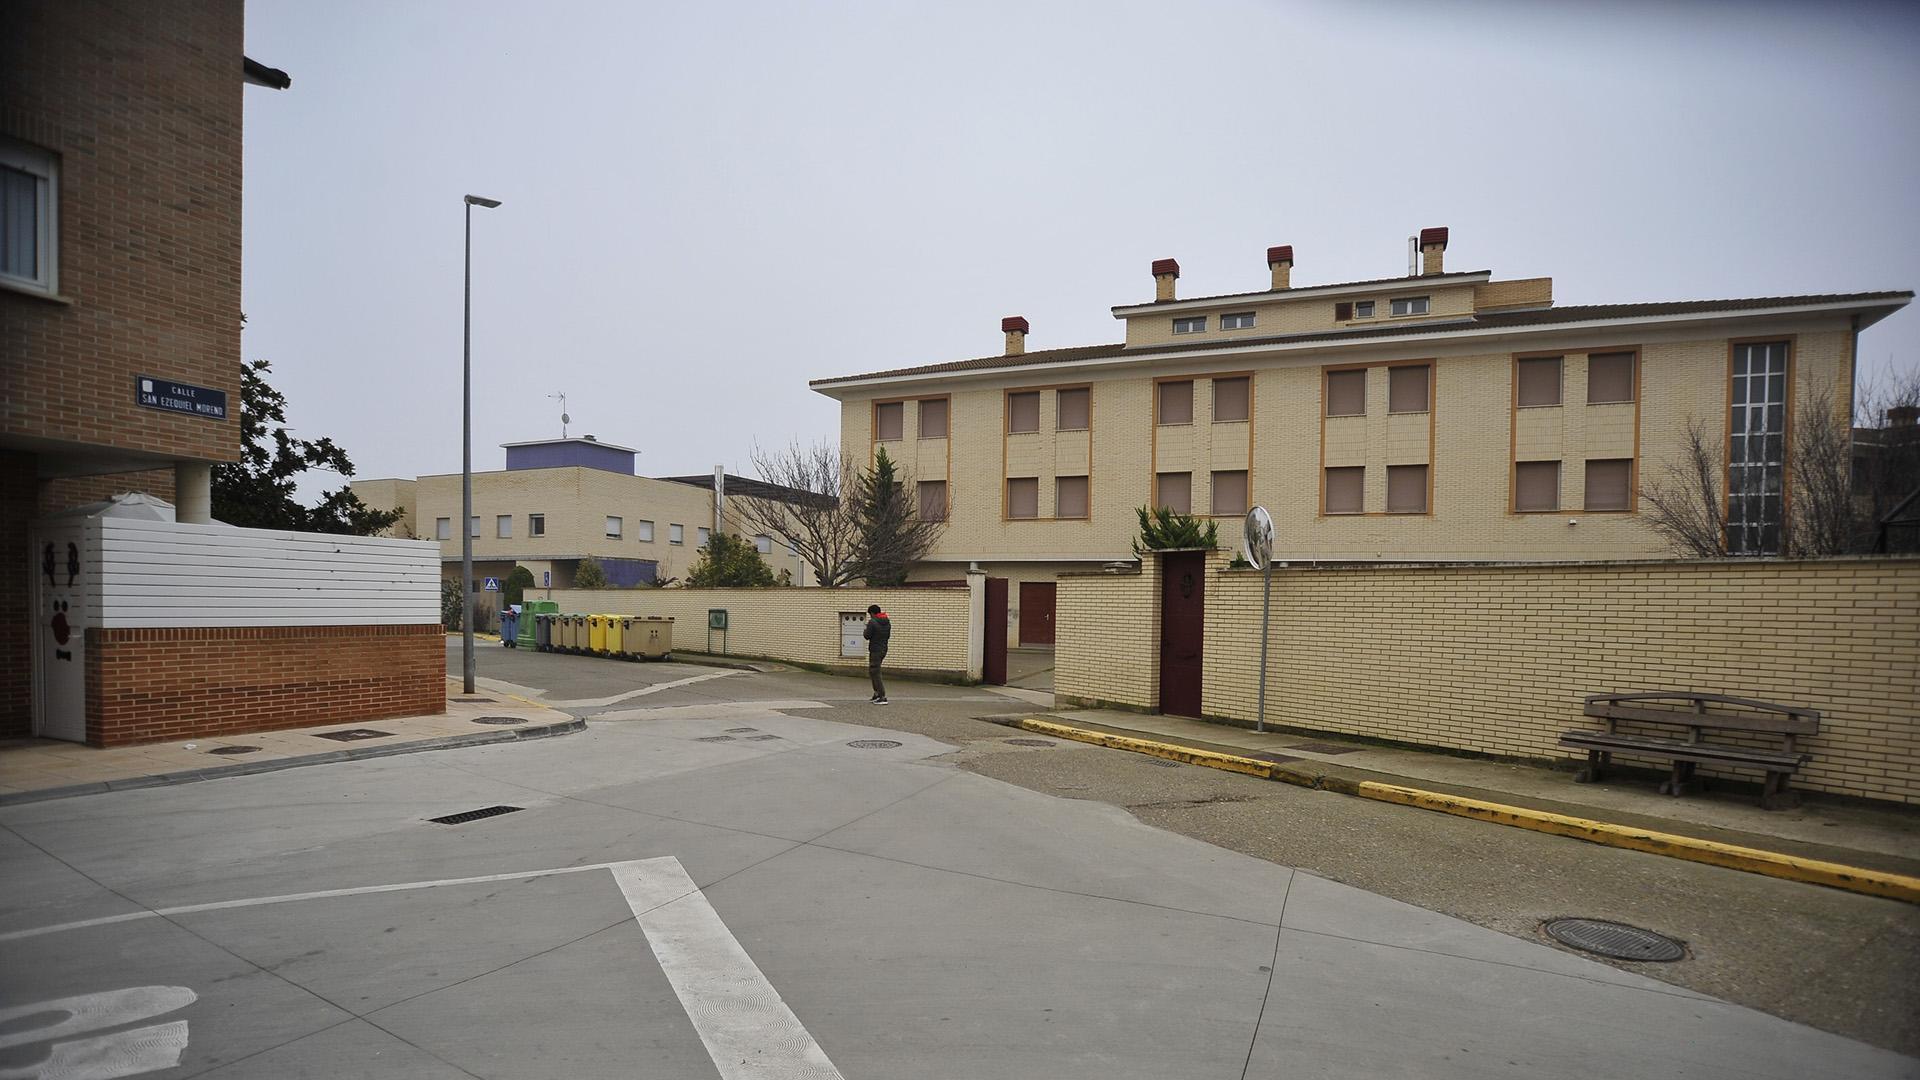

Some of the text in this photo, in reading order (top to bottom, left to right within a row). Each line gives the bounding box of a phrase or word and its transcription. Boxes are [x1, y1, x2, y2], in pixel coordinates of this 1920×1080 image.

[171, 386, 196, 398] CALLE
[142, 394, 223, 415] SAN EZEQUIEL MORENO
